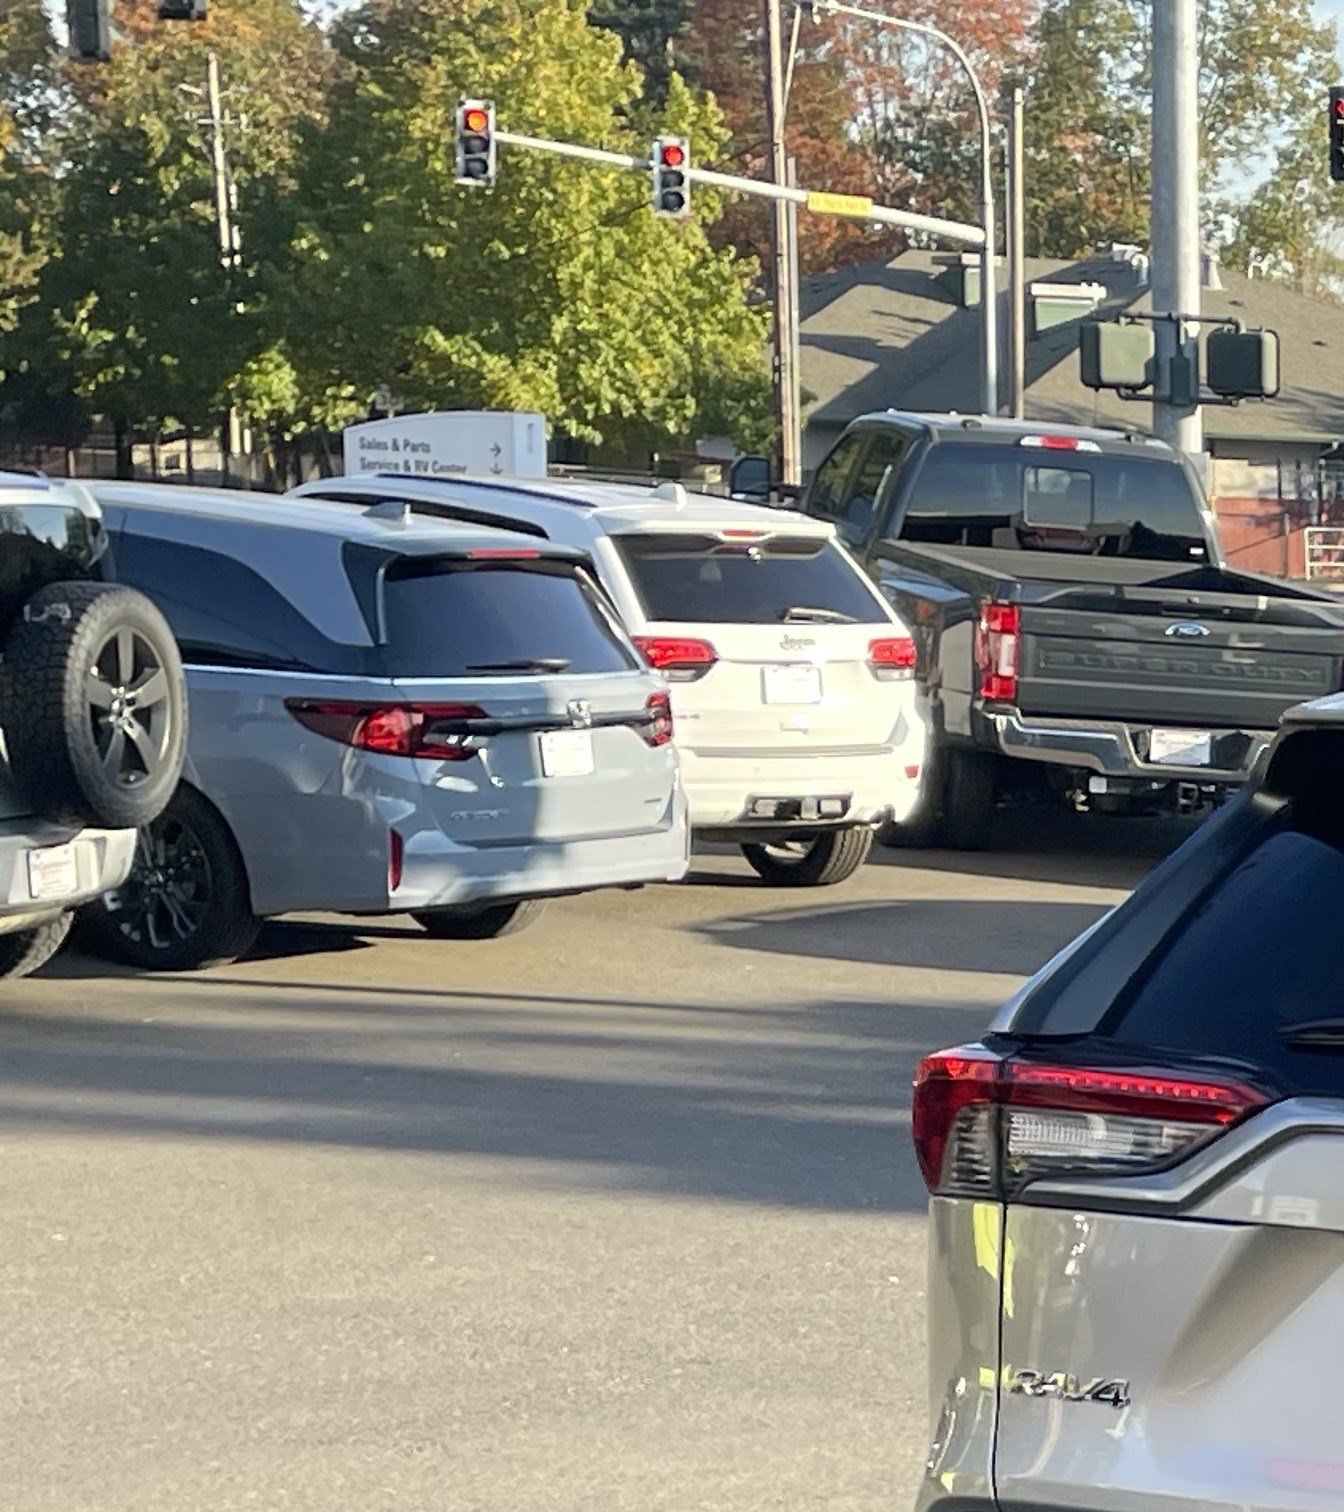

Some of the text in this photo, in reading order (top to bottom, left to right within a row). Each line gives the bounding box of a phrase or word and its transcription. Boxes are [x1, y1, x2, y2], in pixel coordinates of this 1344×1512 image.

[359, 436, 431, 453] Sales & Parts
[360, 457, 400, 472] Service
[402, 459, 411, 473] &
[431, 460, 468, 474] Center
